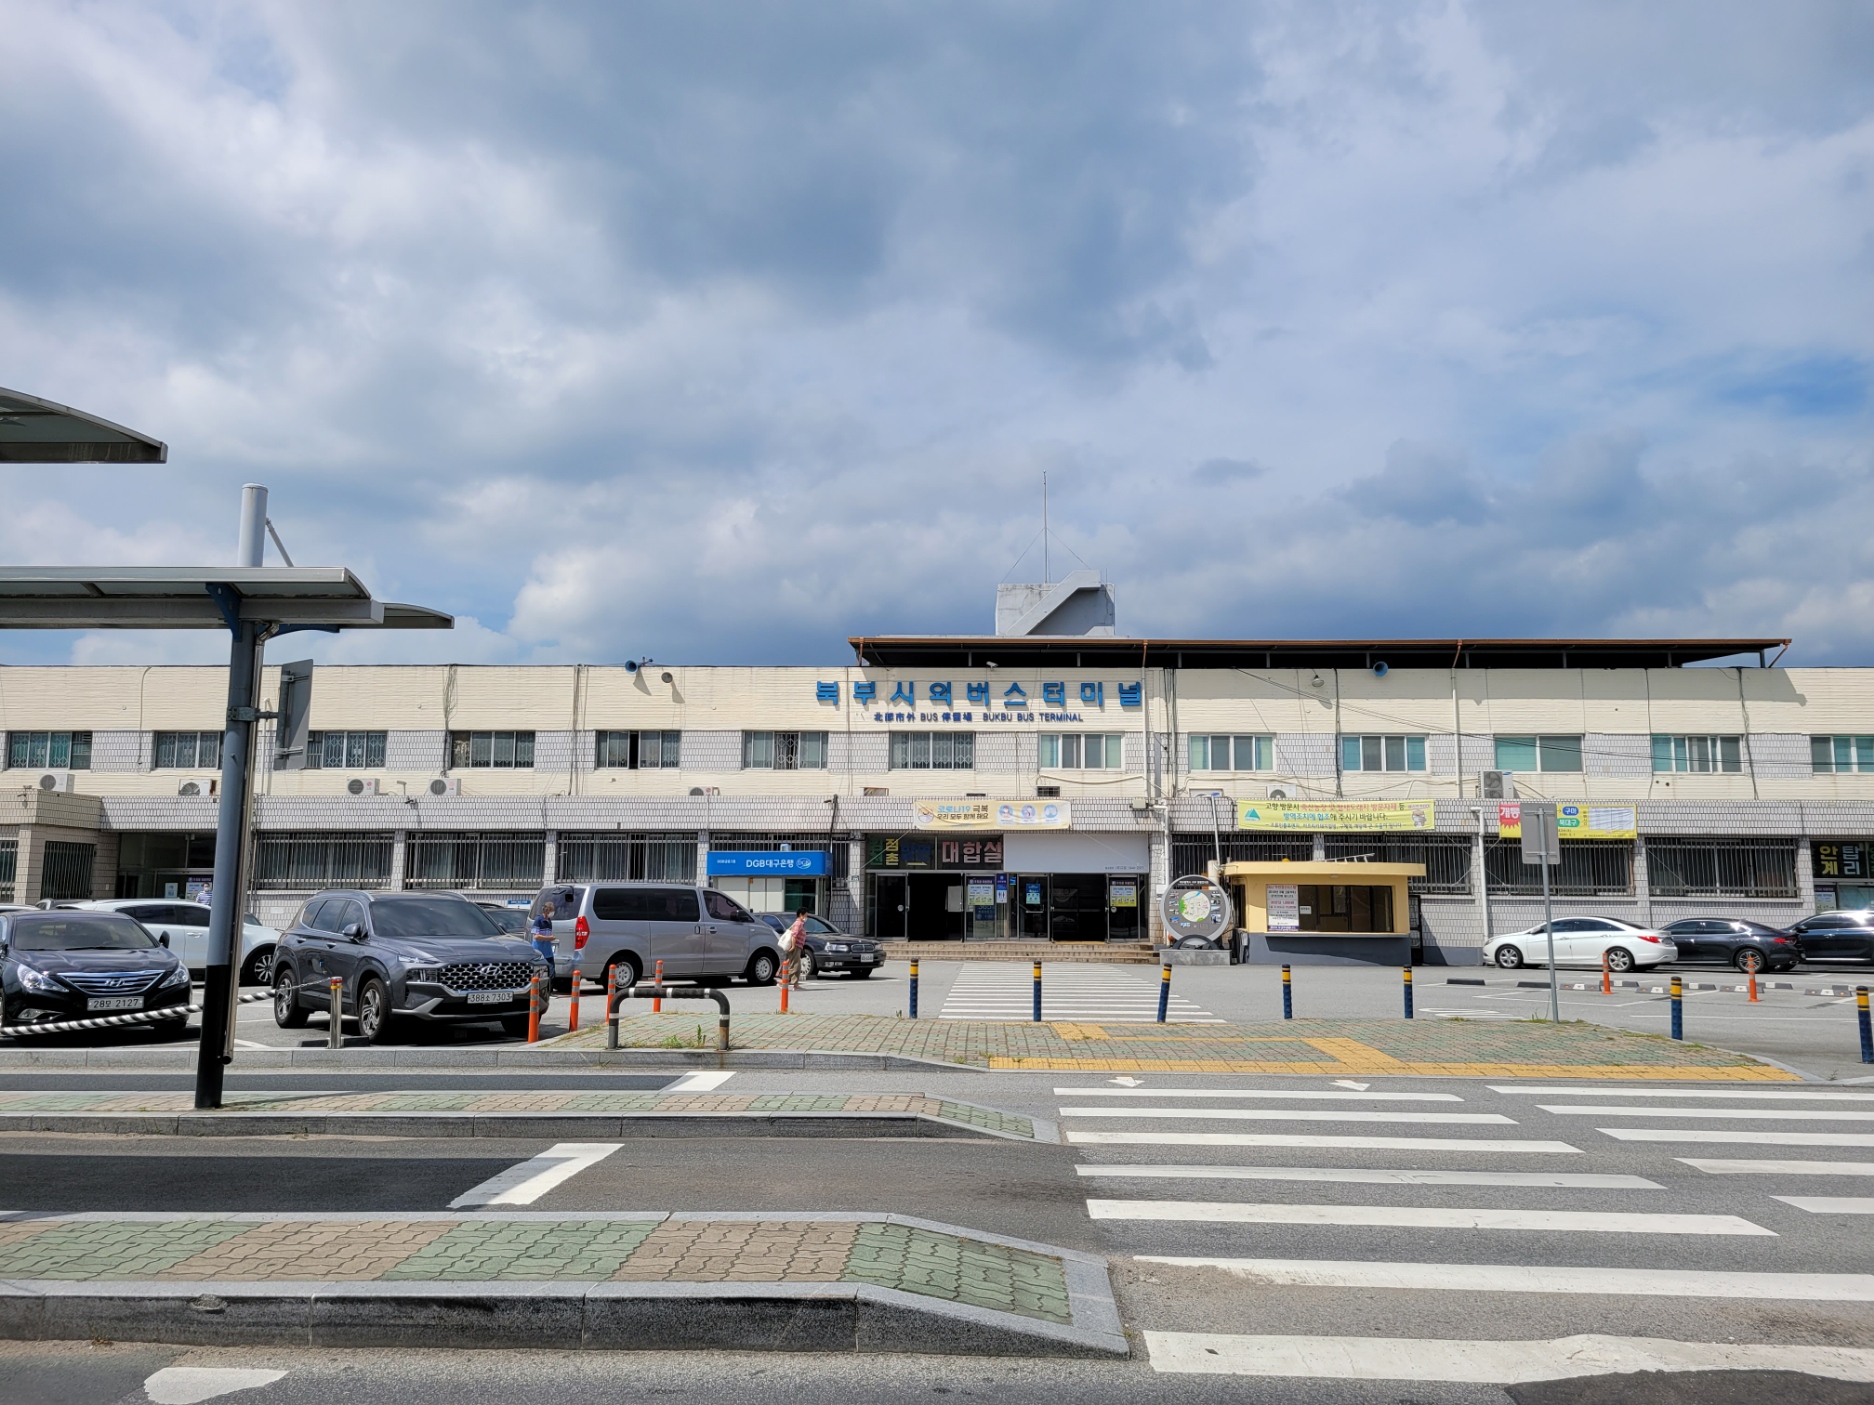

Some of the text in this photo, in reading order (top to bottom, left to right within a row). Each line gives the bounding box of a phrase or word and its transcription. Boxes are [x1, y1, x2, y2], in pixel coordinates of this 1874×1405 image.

[816, 681, 1141, 706] 북부시외버스터미널
[920, 713, 938, 722] BUS
[983, 713, 1013, 722] BUKBU
[1017, 713, 1035, 722] BUS
[1039, 713, 1084, 722] TERMINAL
[938, 805, 988, 813] 코로나19 극복
[1266, 803, 1278, 811] 고향
[1398, 802, 1405, 811] 등
[1338, 812, 1358, 820] 주시기
[1564, 807, 1577, 816] 구미
[885, 838, 899, 865] 점촌
[942, 841, 1002, 863] 대합실
[745, 859, 794, 868] DGB대구은행
[1819, 845, 1839, 875] 안계
[1842, 845, 1861, 875] 탑리
[491, 993, 511, 1001] 7303
[115, 999, 139, 1008] 2127
